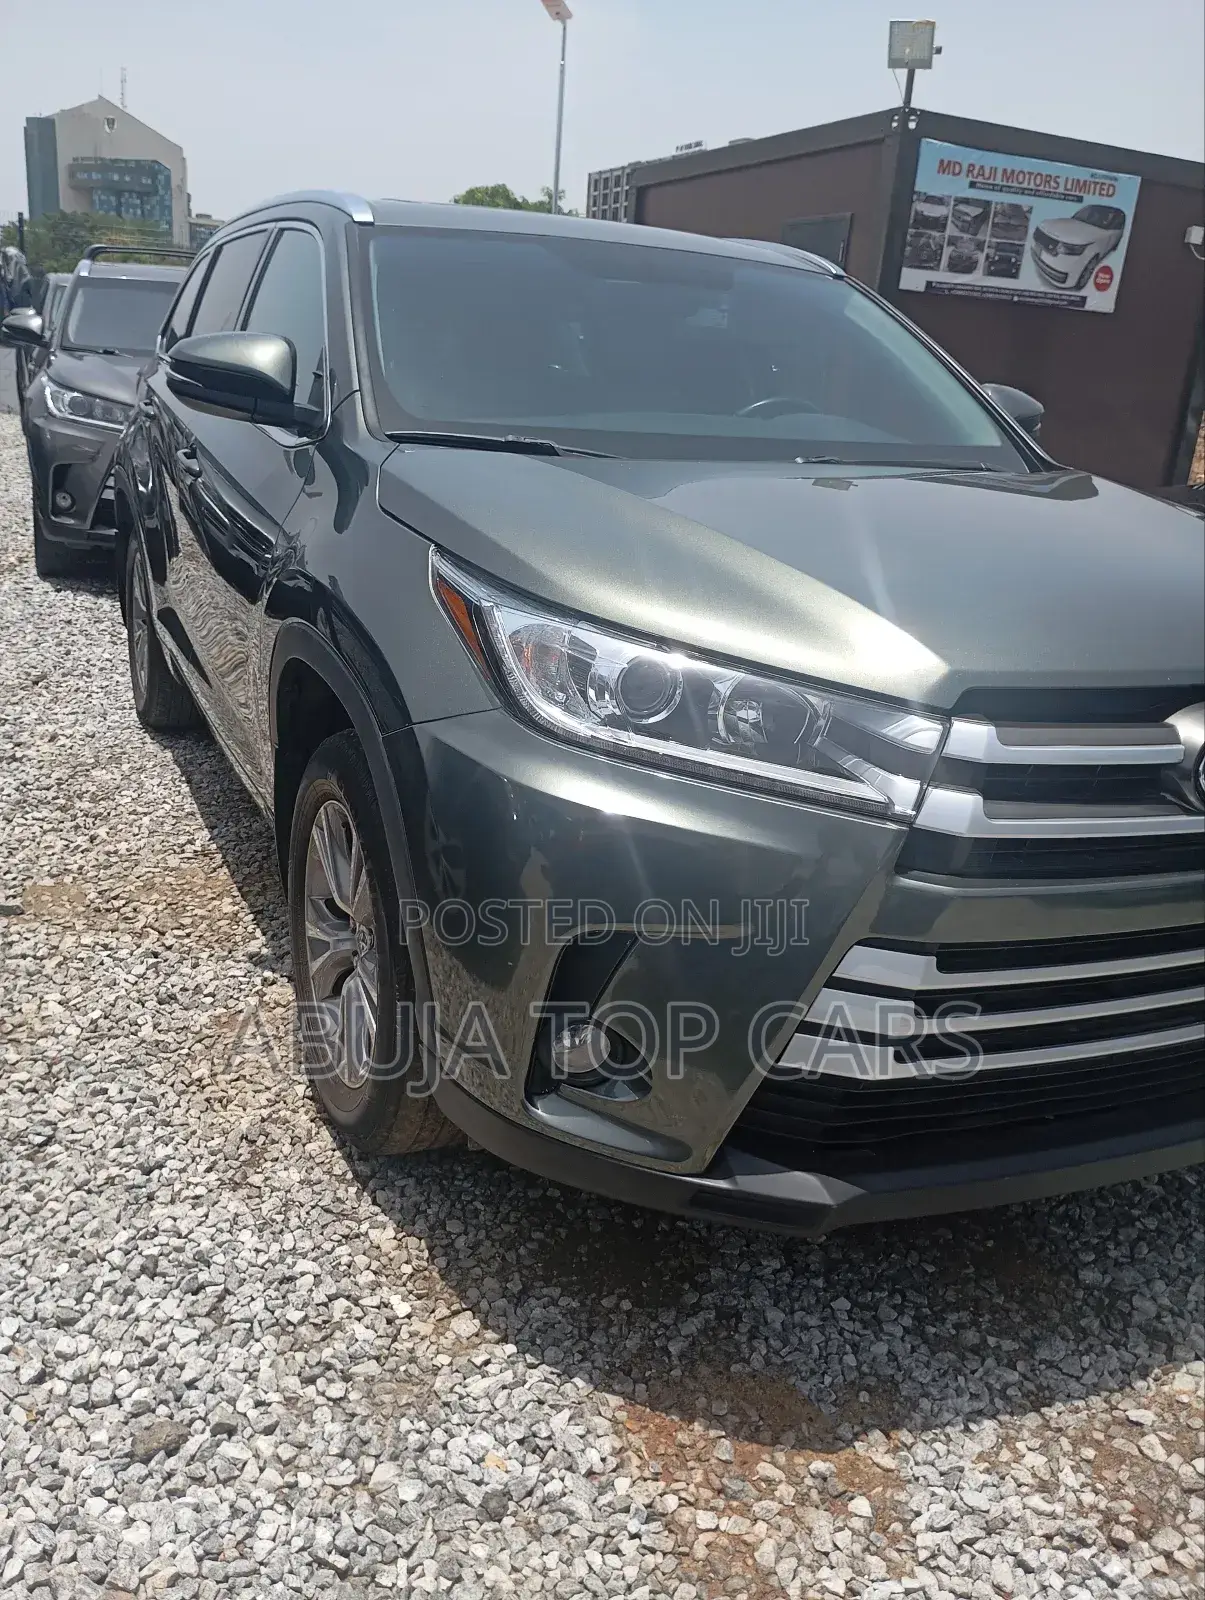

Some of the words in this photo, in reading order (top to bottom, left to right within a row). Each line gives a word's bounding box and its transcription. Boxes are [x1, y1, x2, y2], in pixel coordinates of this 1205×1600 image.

[937, 159, 962, 176] MD
[966, 163, 998, 181] RAJI
[1001, 168, 1060, 190] MOTORS
[1063, 176, 1117, 198] LIMITED
[1002, 185, 1022, 195] quality
[1024, 188, 1035, 196] and
[1036, 189, 1065, 200] affordable
